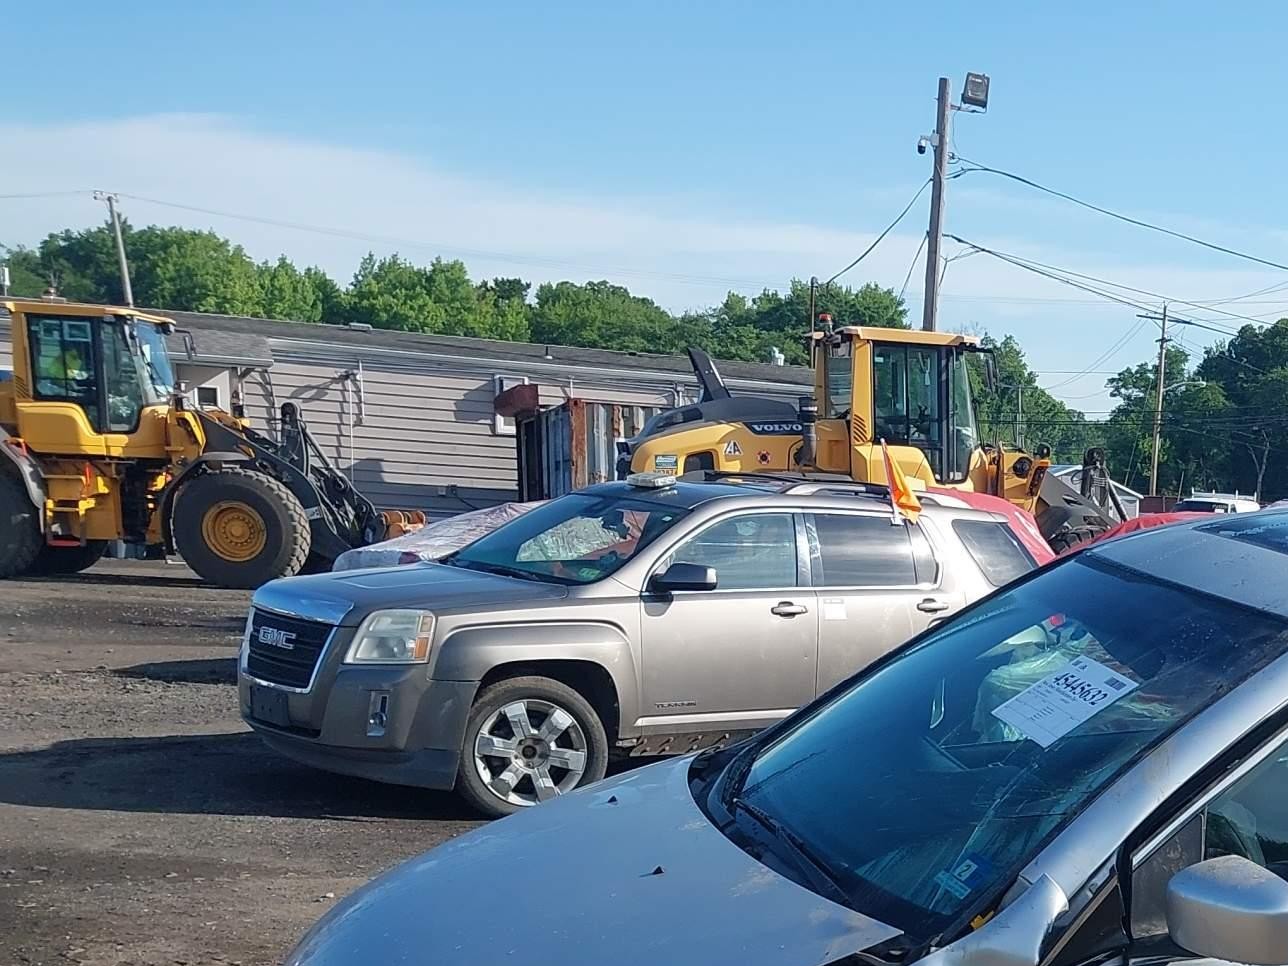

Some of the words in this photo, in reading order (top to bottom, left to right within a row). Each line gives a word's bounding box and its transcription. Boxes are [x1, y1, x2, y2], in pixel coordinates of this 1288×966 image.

[752, 424, 803, 432] VOLVO
[259, 626, 296, 650] GMC
[1053, 672, 1108, 705] 45445632
